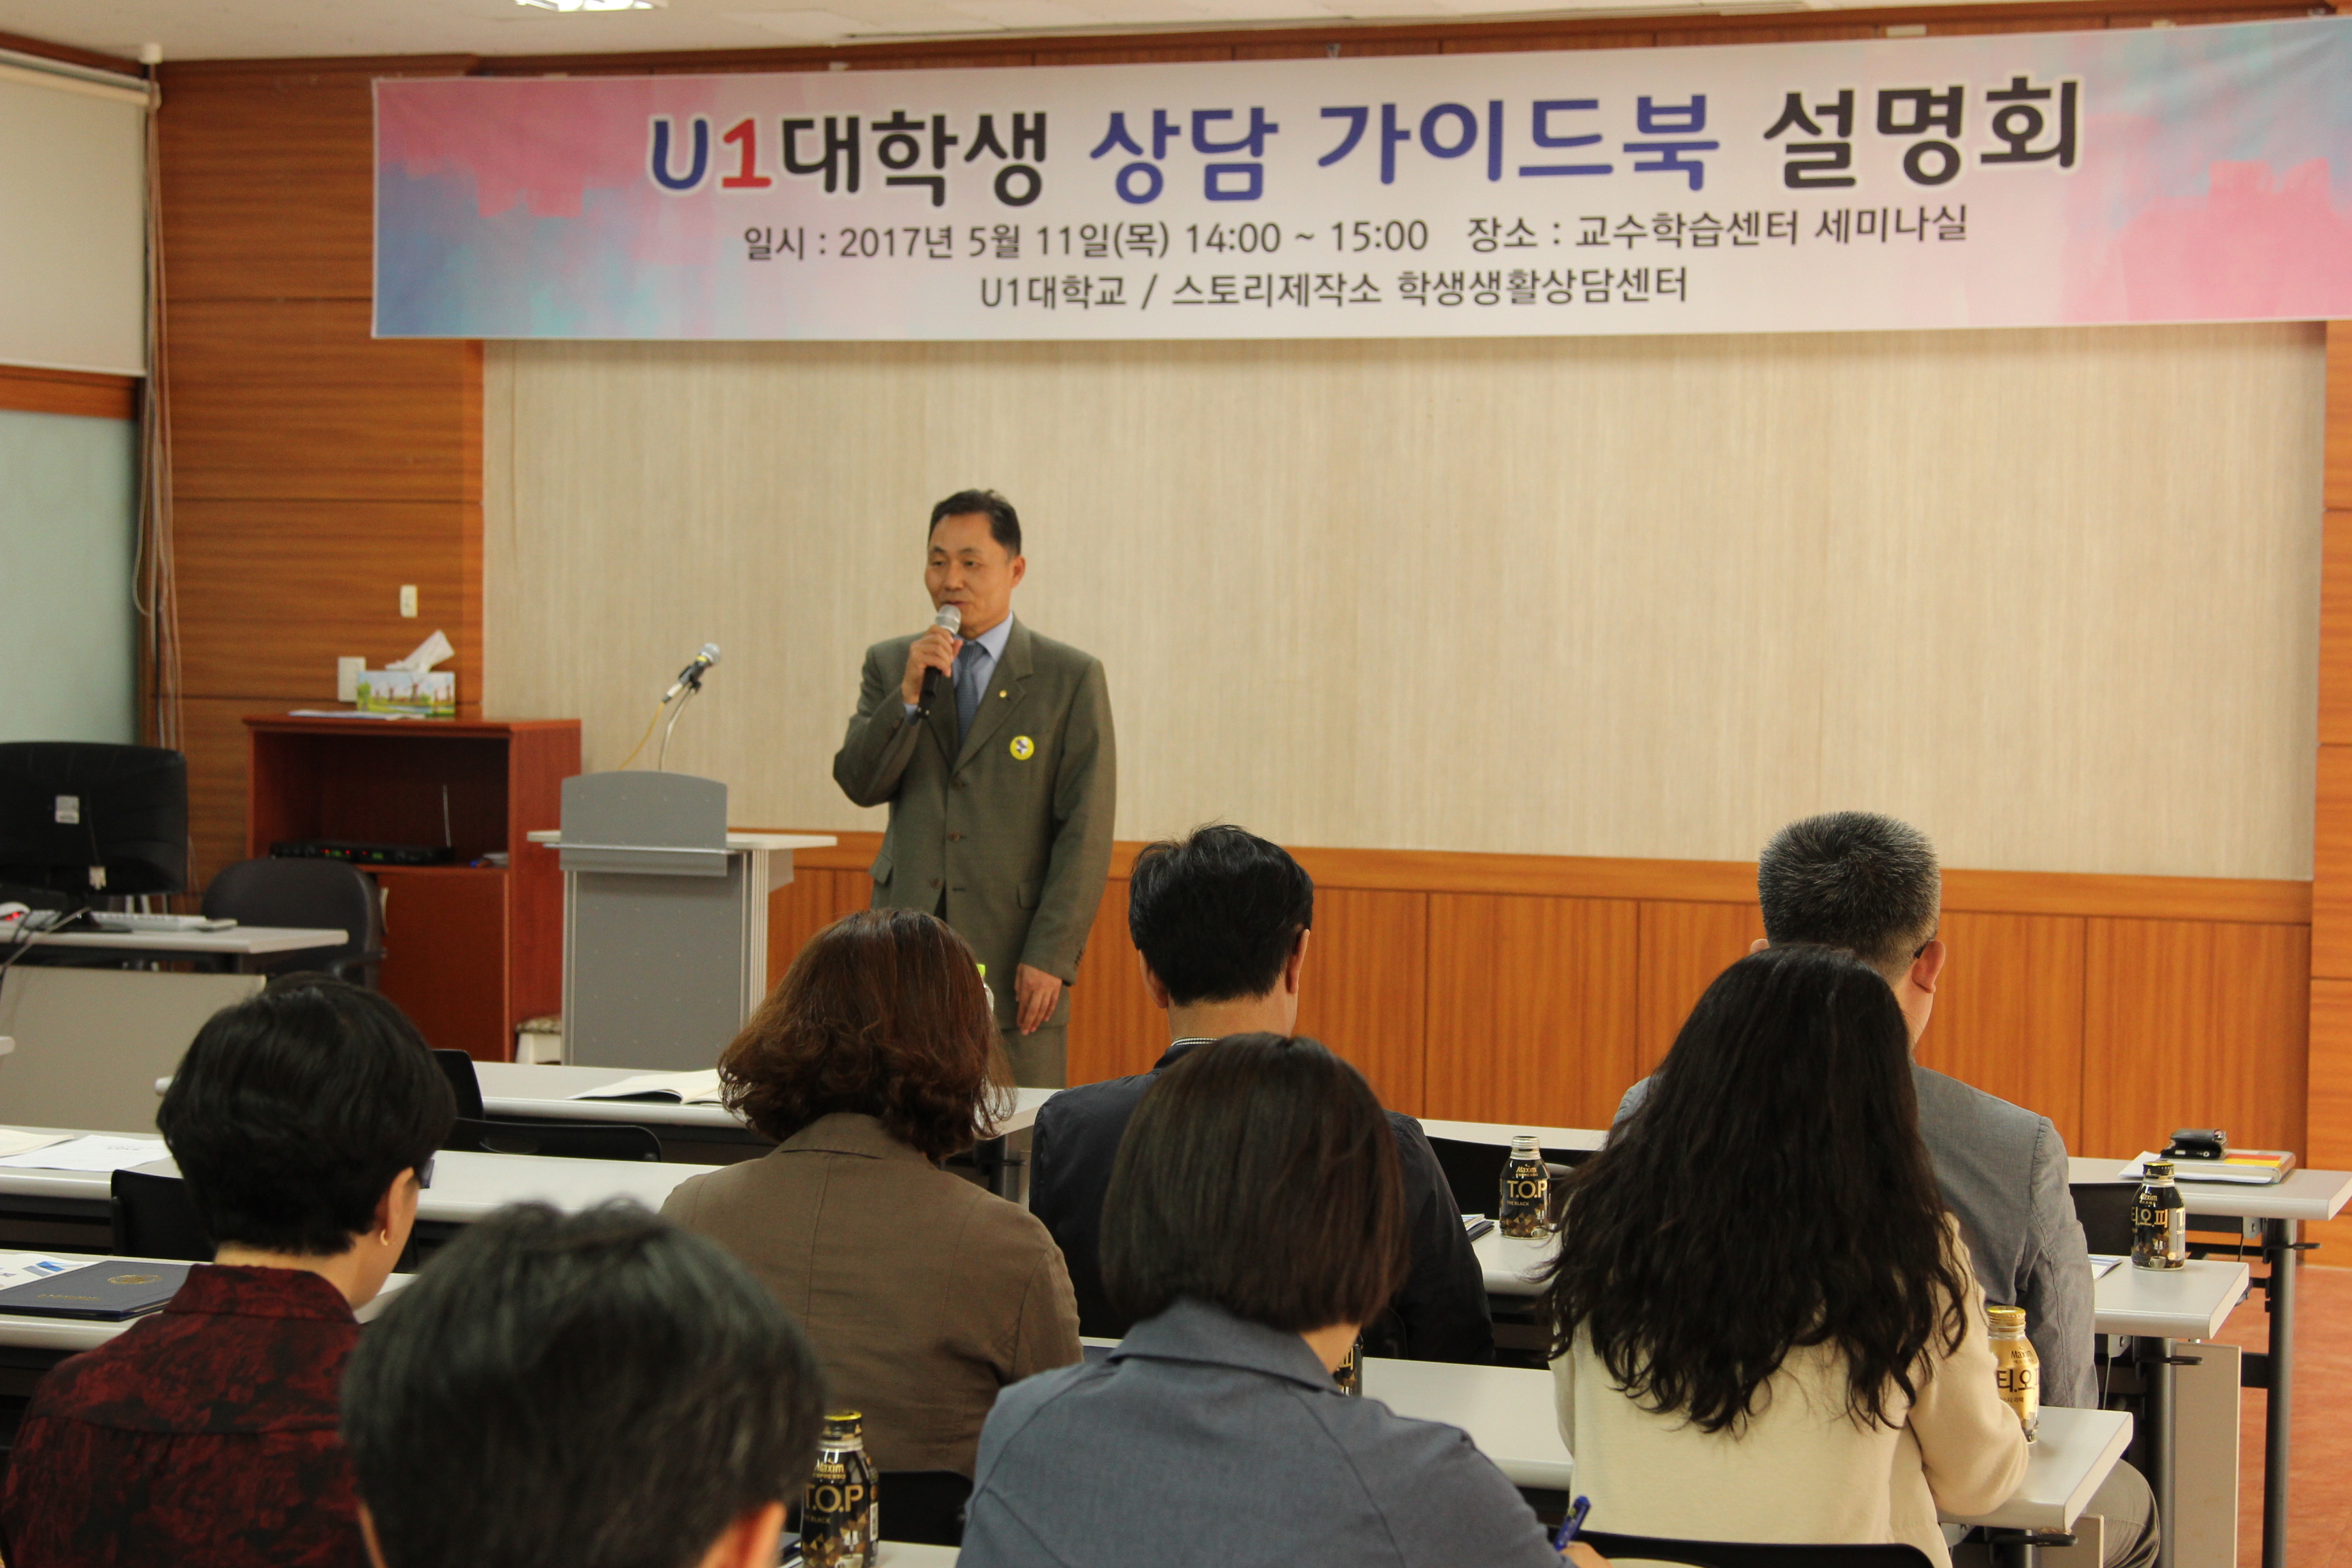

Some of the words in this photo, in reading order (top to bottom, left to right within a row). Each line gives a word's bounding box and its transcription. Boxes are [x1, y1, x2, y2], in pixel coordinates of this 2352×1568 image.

[651, 109, 1048, 208] U1대학생
[1089, 105, 1279, 206] 상담
[1317, 94, 1720, 191] 가이드북
[1763, 75, 2079, 189] 설명회
[743, 226, 804, 261] 일시
[839, 225, 953, 259] 2017년
[969, 223, 1020, 259] 5월
[1036, 220, 1170, 259] 11일(목)
[1186, 222, 1282, 253] 14:00
[1331, 219, 1430, 252] 15:00
[1468, 216, 1539, 253] 장소
[1575, 209, 1799, 250] 교수학습센터
[1814, 203, 1967, 244] 세미나실
[981, 274, 1128, 310] U1대학교
[1171, 272, 1383, 308] 스토리제작소
[1397, 266, 1688, 307] 학생생활상담센터
[1507, 1179, 1548, 1199] T.O.P
[2010, 1350, 2034, 1359] Maxim
[805, 1484, 864, 1513] T.O.P
